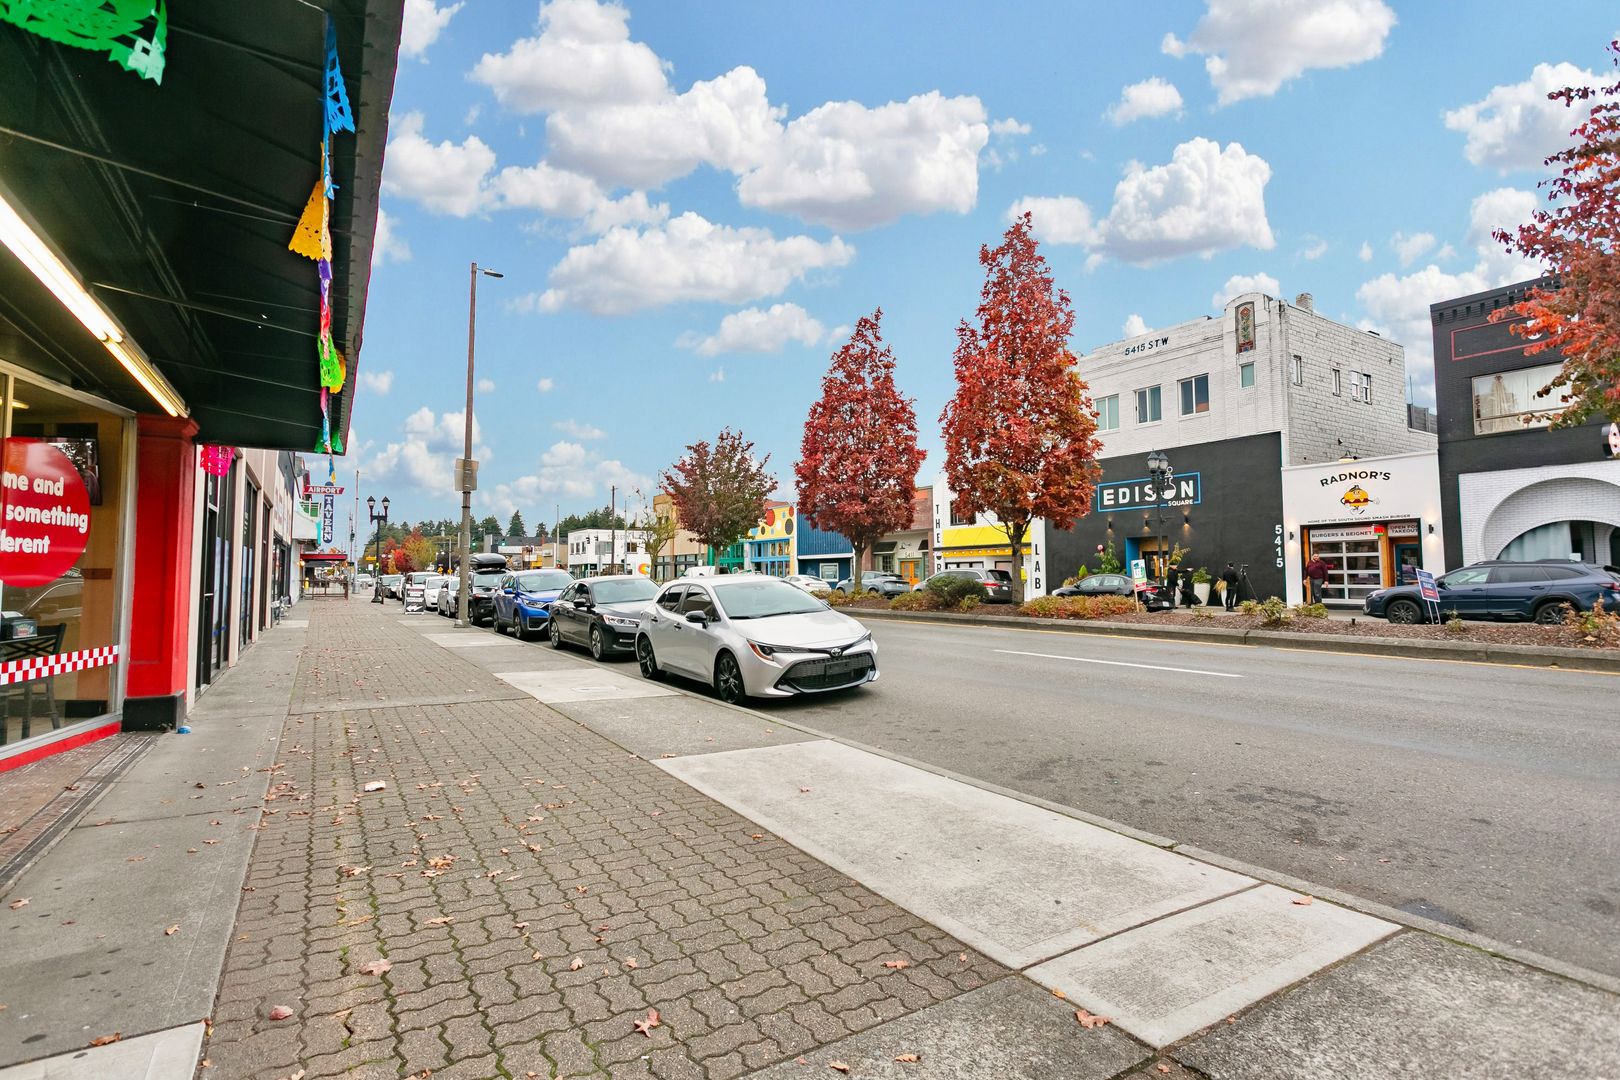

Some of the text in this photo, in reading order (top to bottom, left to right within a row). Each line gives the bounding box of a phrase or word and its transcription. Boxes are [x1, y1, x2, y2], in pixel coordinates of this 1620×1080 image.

[1124, 343, 1146, 356] 5415
[33, 476, 64, 496] and
[308, 486, 341, 494] AIRPORT
[1103, 474, 1194, 506] EDISON
[1320, 470, 1392, 487] RADNOR'S
[6, 504, 88, 534] something
[324, 496, 333, 540] TAVERN
[1274, 524, 1284, 568] 5415
